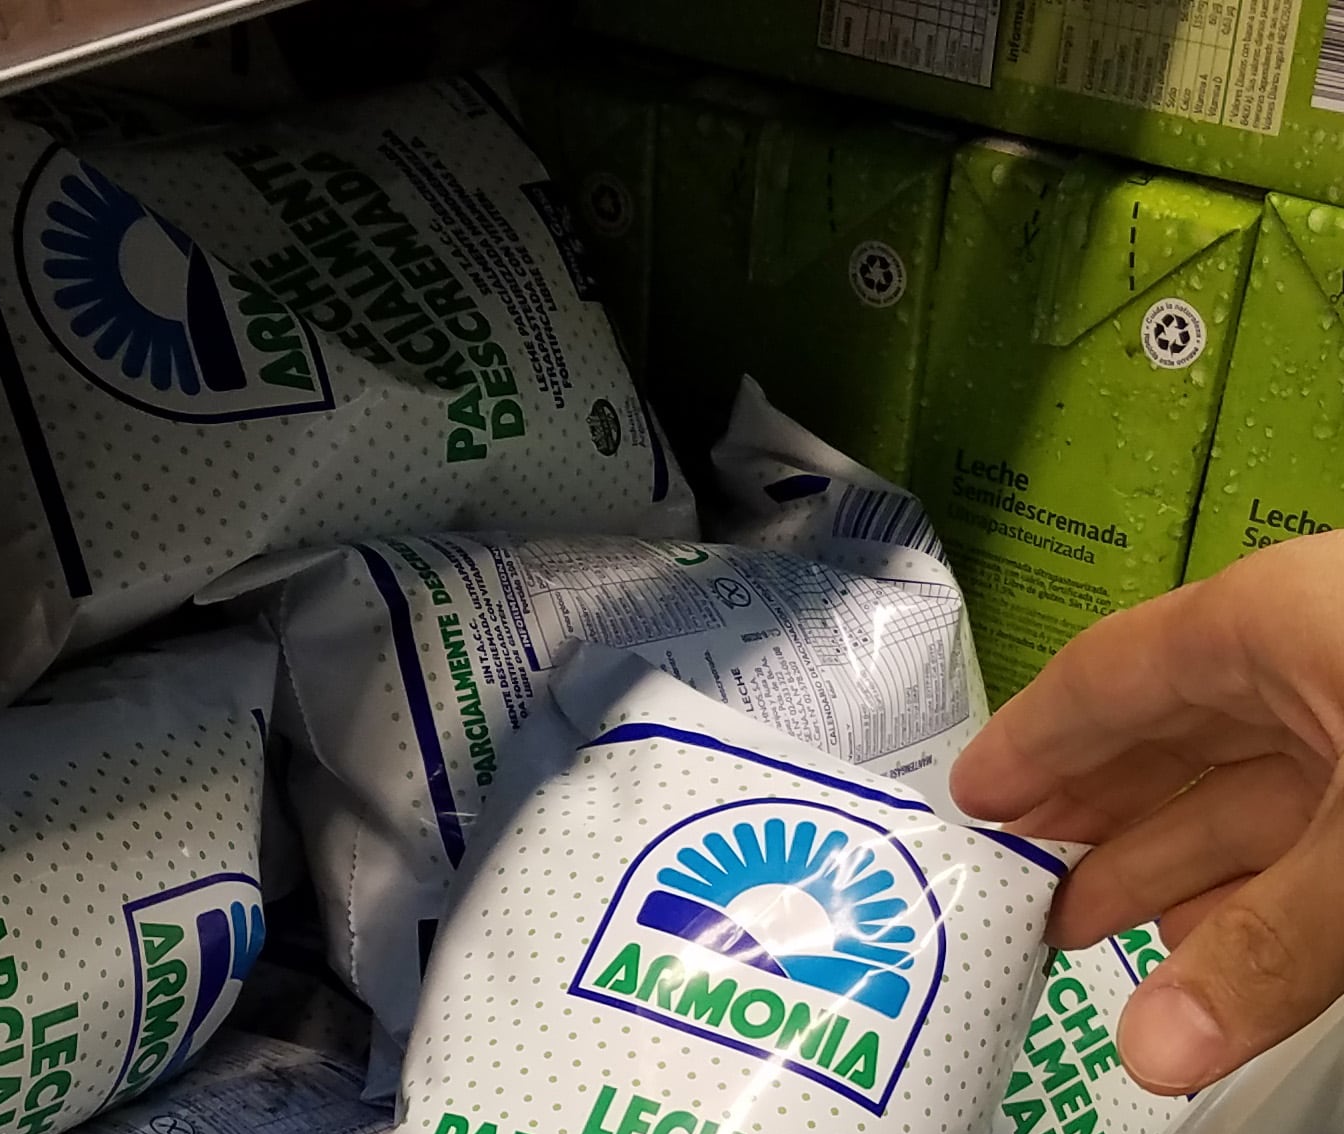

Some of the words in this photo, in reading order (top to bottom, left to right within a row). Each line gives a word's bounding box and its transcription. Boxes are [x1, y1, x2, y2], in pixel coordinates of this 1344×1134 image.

[956, 449, 1030, 492] Leche
[951, 476, 1130, 550] Semidescremada
[1248, 498, 1335, 534] Leche
[731, 667, 754, 713] LECHE
[593, 941, 880, 1090] ARMONIA
